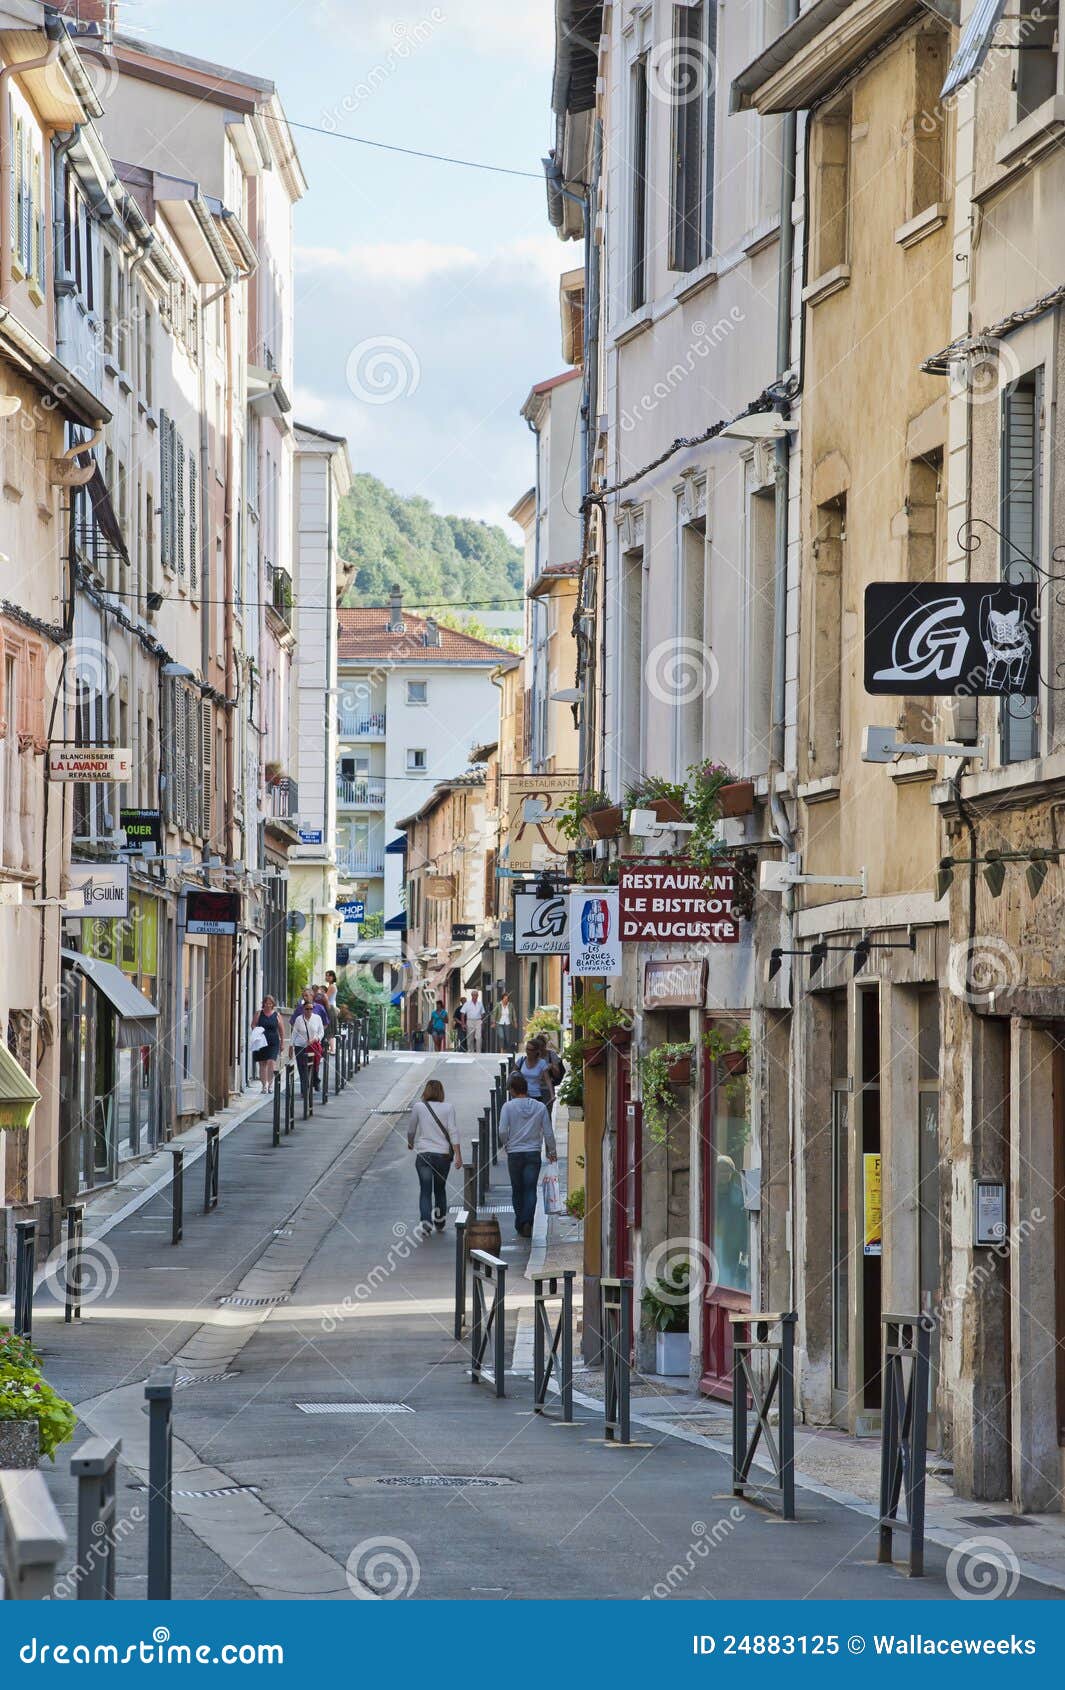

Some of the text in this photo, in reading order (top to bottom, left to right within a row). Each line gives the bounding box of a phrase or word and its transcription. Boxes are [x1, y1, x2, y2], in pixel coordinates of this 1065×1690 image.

[51, 762, 64, 771] LA
[519, 779, 575, 788] RESTAURANT
[622, 874, 734, 890] RESTAURANT
[339, 905, 363, 914] SHOP
[624, 898, 733, 913] LE BISTROT
[624, 922, 735, 937] D'AUGUSTE
